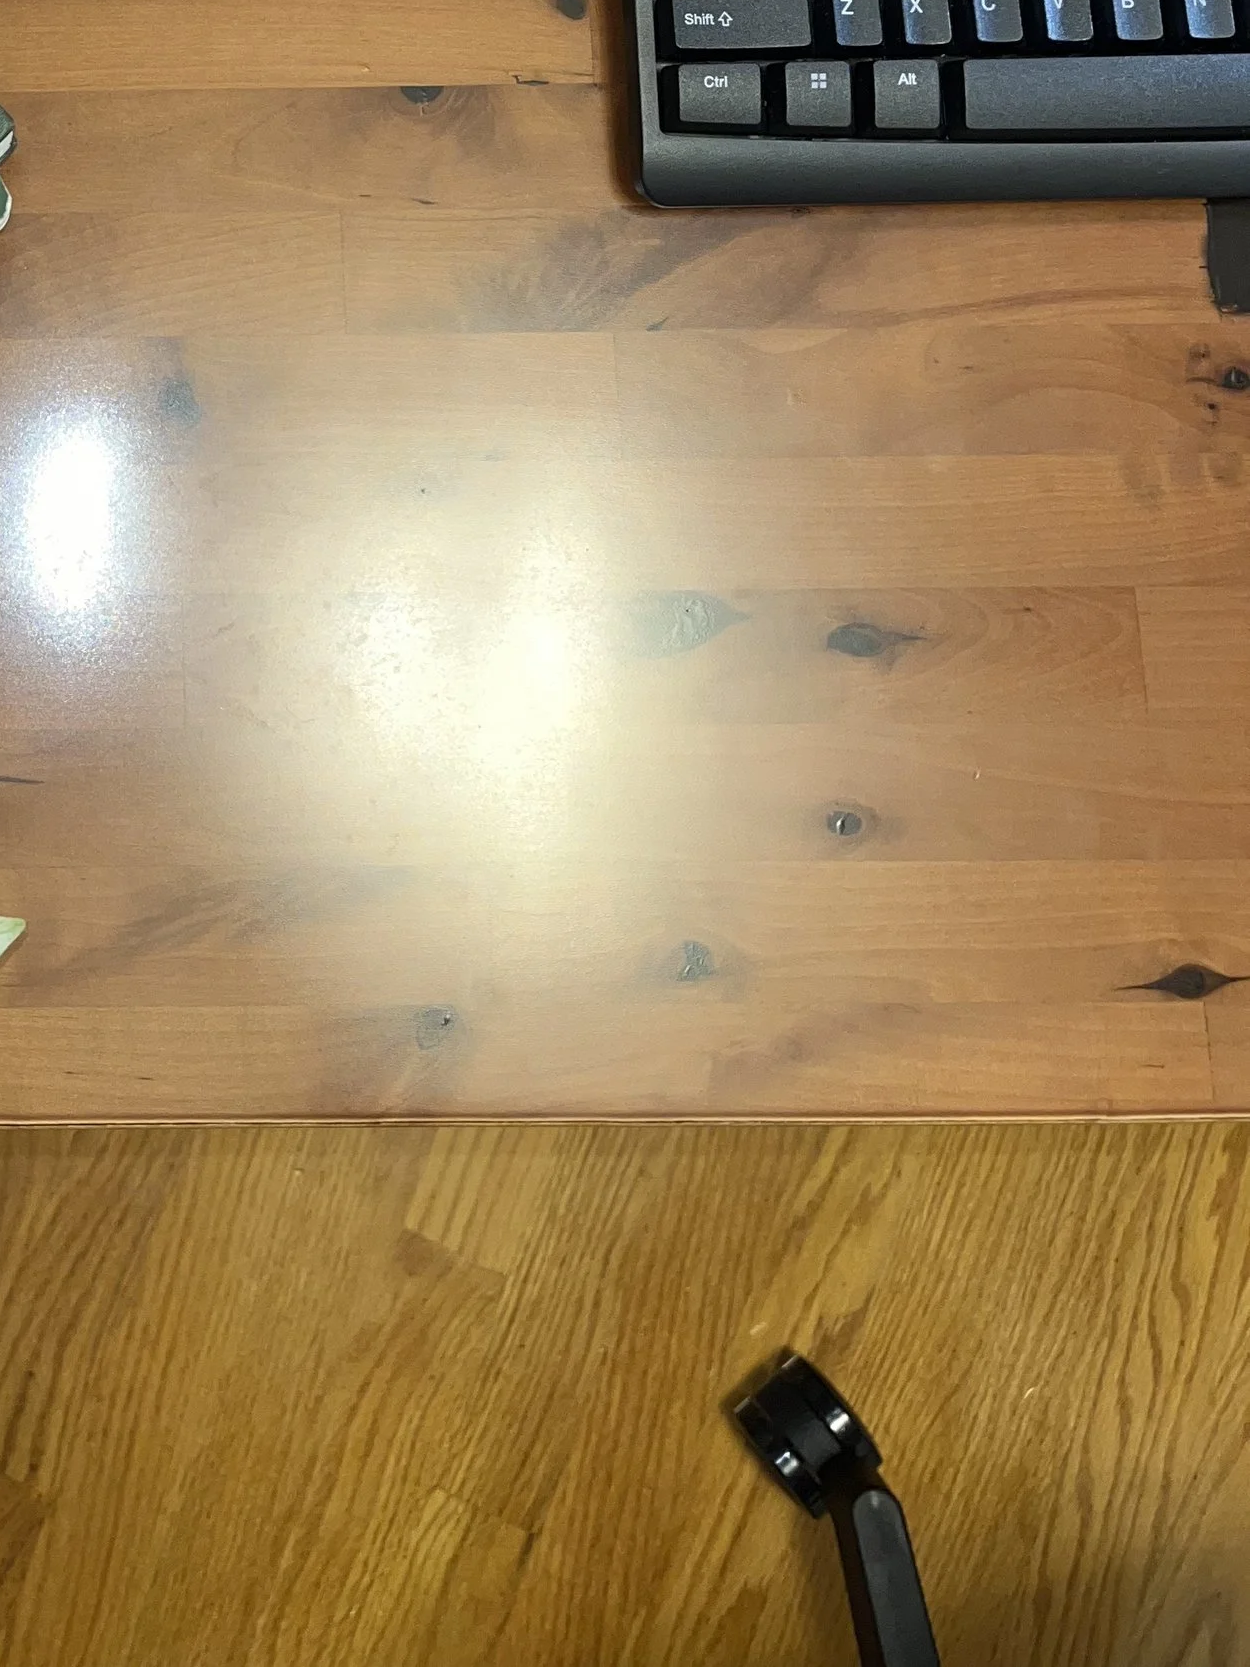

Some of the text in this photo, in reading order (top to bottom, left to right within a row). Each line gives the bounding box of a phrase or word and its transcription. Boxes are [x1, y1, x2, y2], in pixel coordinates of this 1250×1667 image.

[684, 13, 715, 26] Shift
[703, 75, 729, 89] Ctrl
[897, 72, 918, 86] Alt
